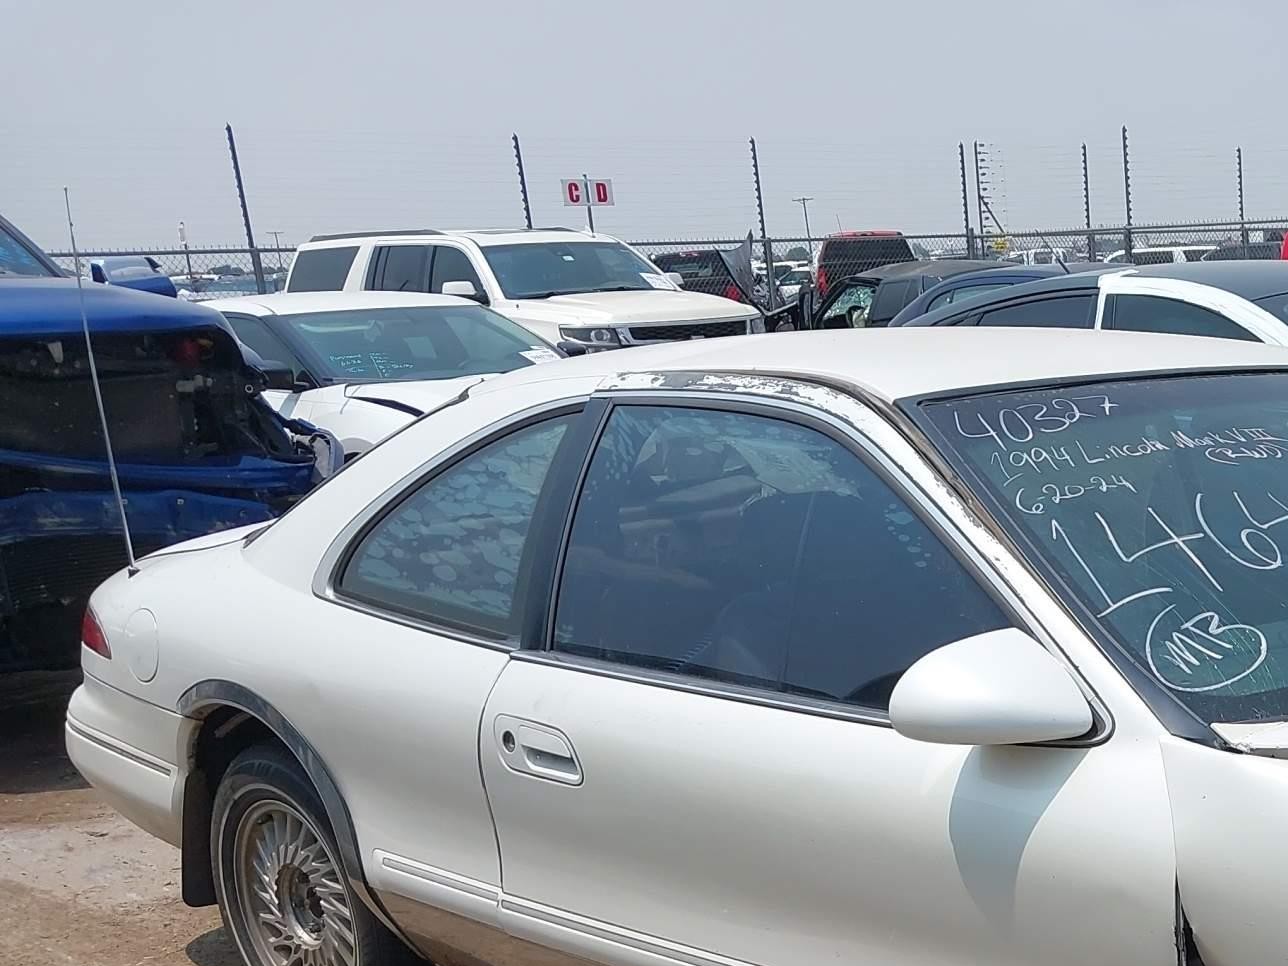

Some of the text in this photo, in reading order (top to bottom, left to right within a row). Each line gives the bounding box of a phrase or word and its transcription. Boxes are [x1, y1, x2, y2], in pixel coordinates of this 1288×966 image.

[567, 182, 580, 203] C
[595, 182, 608, 203] D
[954, 395, 1120, 452] 40327
[990, 446, 1076, 487] 1994
[1015, 474, 1138, 514] 6-20-24
